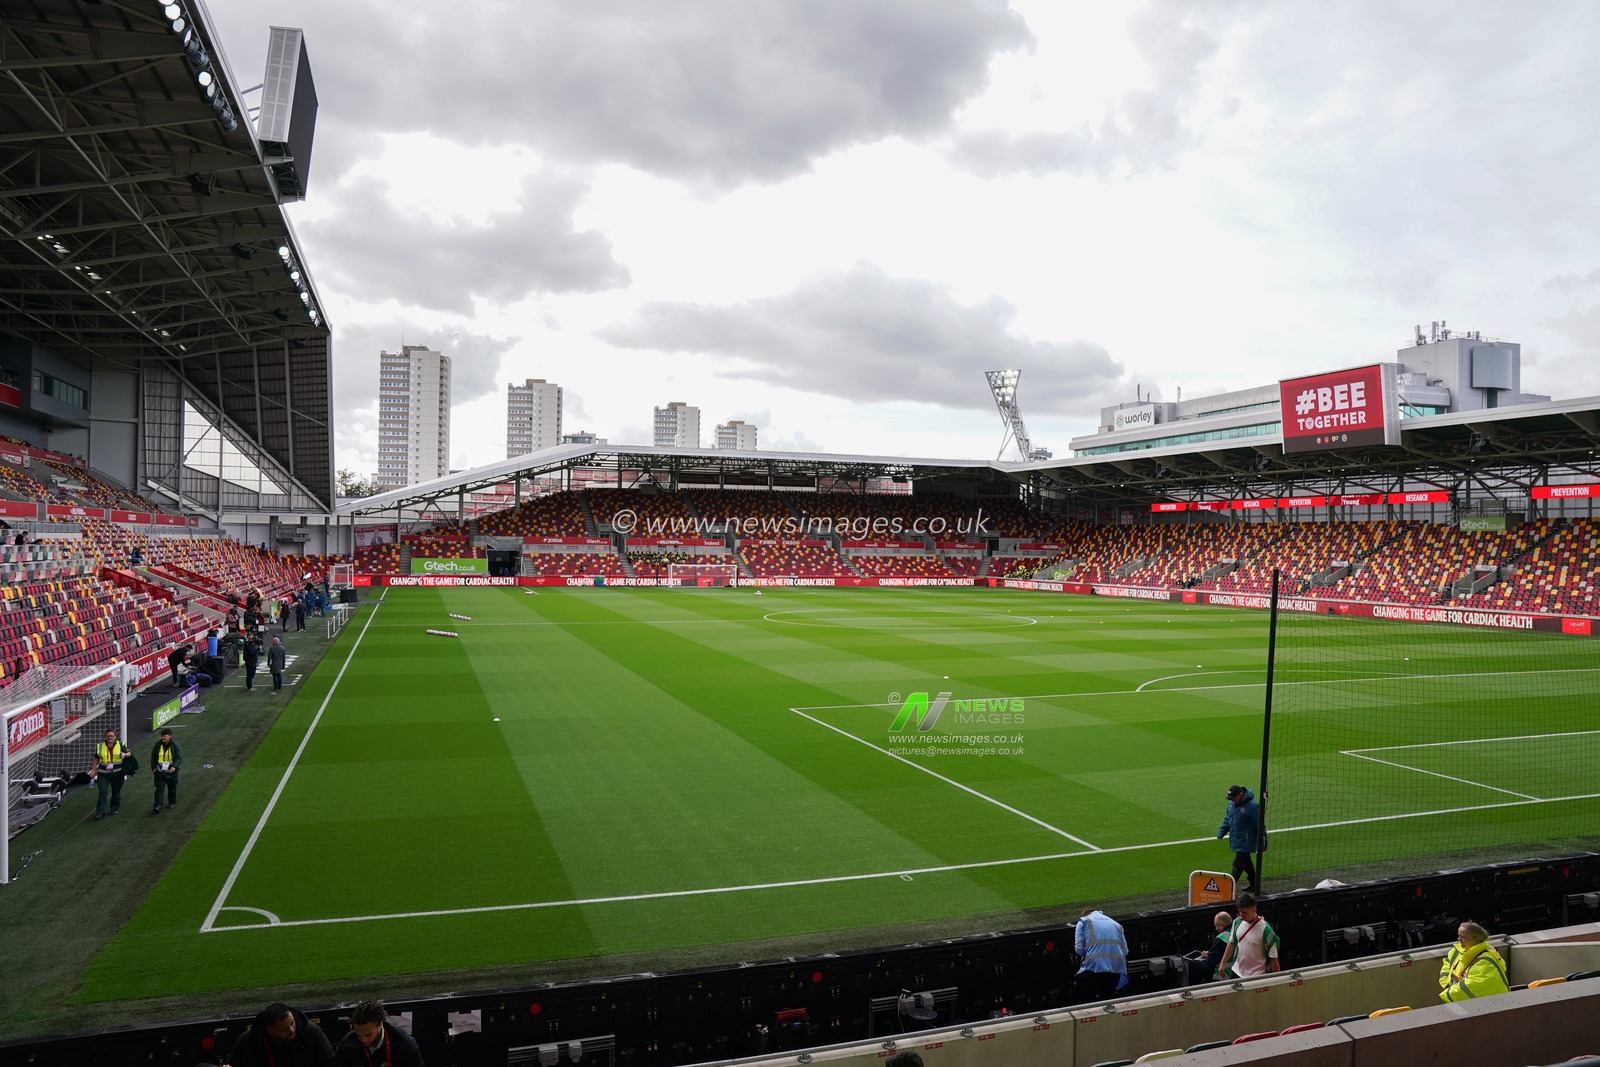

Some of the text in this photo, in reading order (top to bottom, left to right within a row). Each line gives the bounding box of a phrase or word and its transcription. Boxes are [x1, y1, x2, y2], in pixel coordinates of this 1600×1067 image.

[1296, 381, 1366, 416] #BEE
[1124, 410, 1152, 424] worley
[1297, 410, 1366, 430] TOGETHER
[1550, 486, 1590, 496] PREVENTION
[1406, 494, 1428, 502] RESEARCH
[1460, 520, 1506, 530] Gtech.co.uk
[424, 560, 476, 571] Gtech.co.uk
[390, 577, 514, 586] CHANGING THE GAME FOR CARDIAC HEALTH
[566, 578, 594, 586] CHANGIN
[610, 578, 625, 586] GAME
[626, 578, 636, 586] FOR
[1209, 594, 1316, 611] CHANGING THE GAME FOR RDIAC HEALTH
[1373, 606, 1533, 629] CHANGING THE GAME FOR CARDIAC HEALTH
[17, 710, 44, 742] Joma
